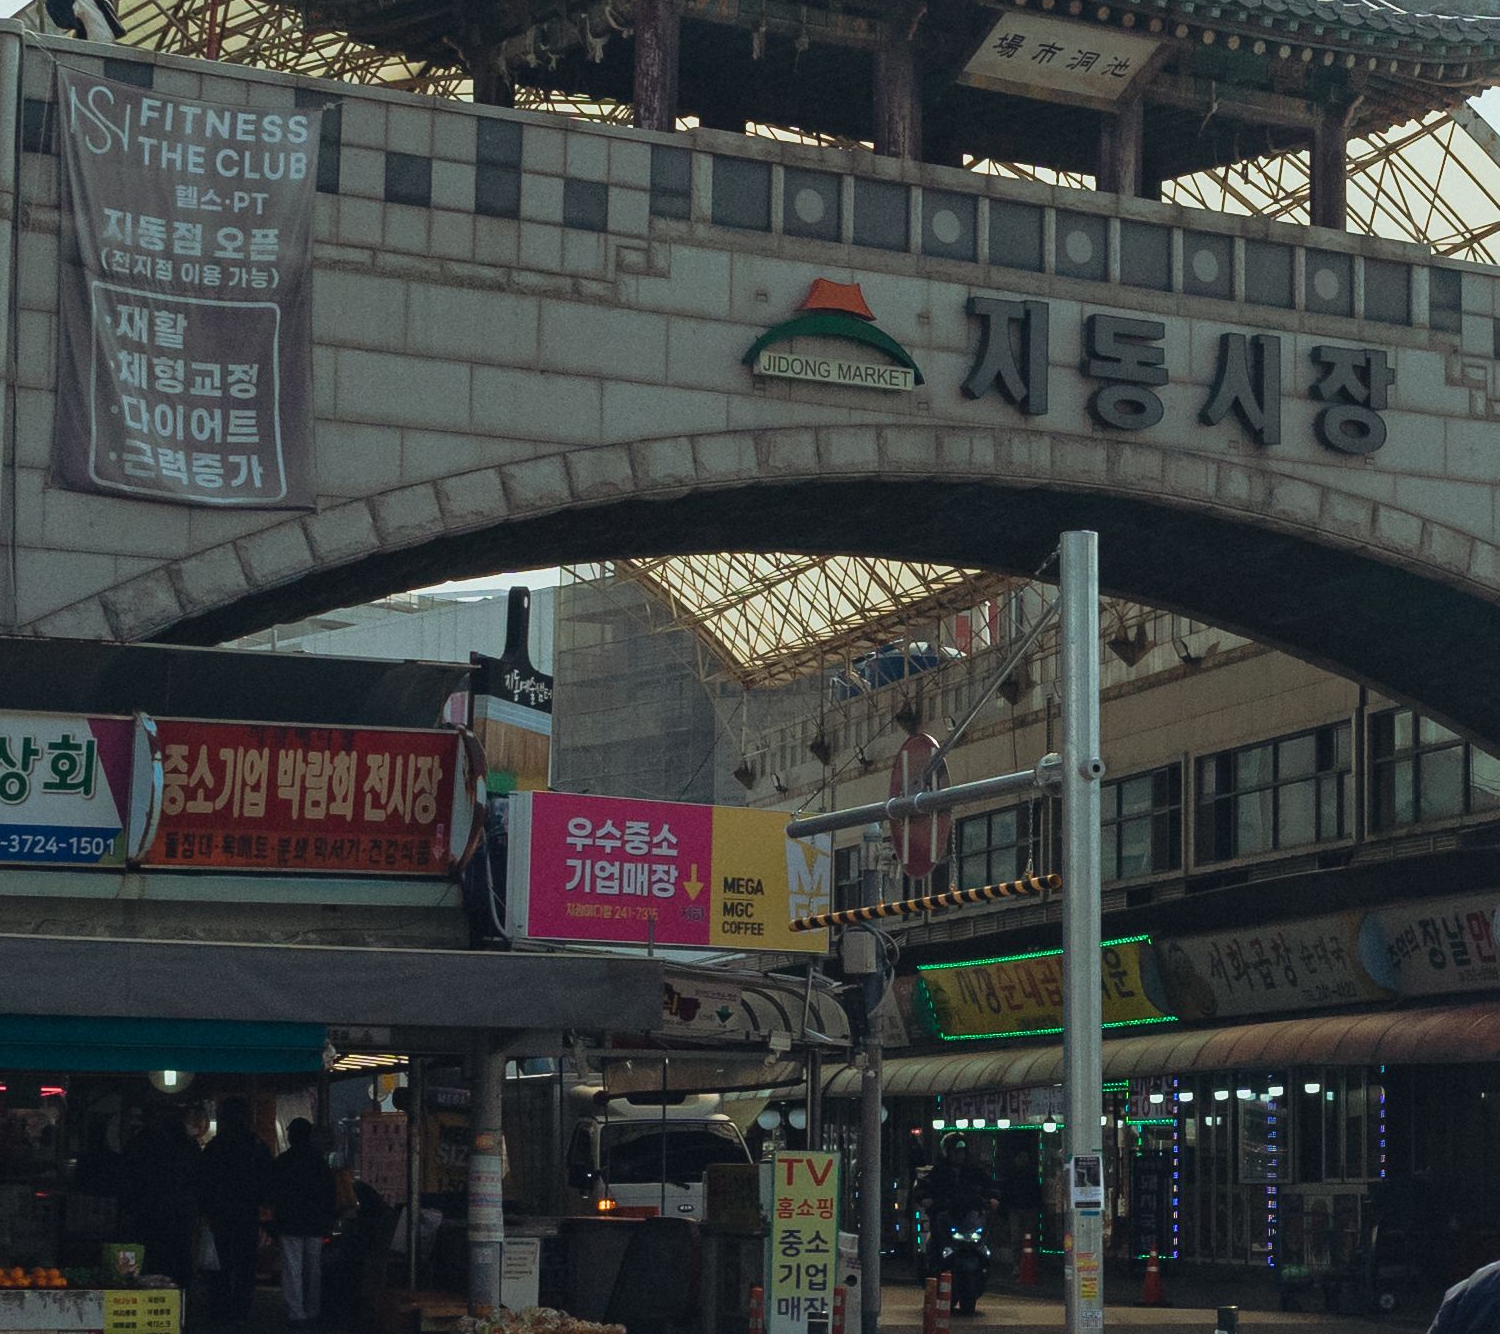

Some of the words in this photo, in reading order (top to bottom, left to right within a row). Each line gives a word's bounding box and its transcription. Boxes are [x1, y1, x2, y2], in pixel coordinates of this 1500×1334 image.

[138, 96, 311, 145] FITNESS
[137, 135, 206, 175] THE
[214, 147, 309, 181] CLUB
[174, 183, 271, 217] 헬스·PT
[102, 207, 203, 257] 지동점
[213, 227, 282, 262] 오픈
[180, 264, 222, 288] 이용
[227, 266, 281, 291] 가능)
[115, 305, 188, 351] 재활
[116, 351, 260, 402] 체형교정
[760, 353, 832, 381] JIDONG
[835, 361, 913, 390] MARKET
[959, 293, 1396, 456] 지동시장
[122, 395, 261, 446] 다이어트
[121, 438, 265, 490] 근력증가
[161, 743, 271, 819] 중소기업
[276, 748, 358, 823] 박람회
[362, 752, 444, 825] 전시장
[565, 816, 679, 858] 우수중소
[564, 858, 679, 899] 기업매장
[722, 876, 765, 898] MEGA
[721, 919, 765, 937] COFFEE
[722, 902, 754, 919] MGC
[777, 1156, 835, 1187] TV
[775, 1196, 835, 1221] 홈쇼핑
[778, 1229, 831, 1258] 중소
[778, 1263, 829, 1292] 기업
